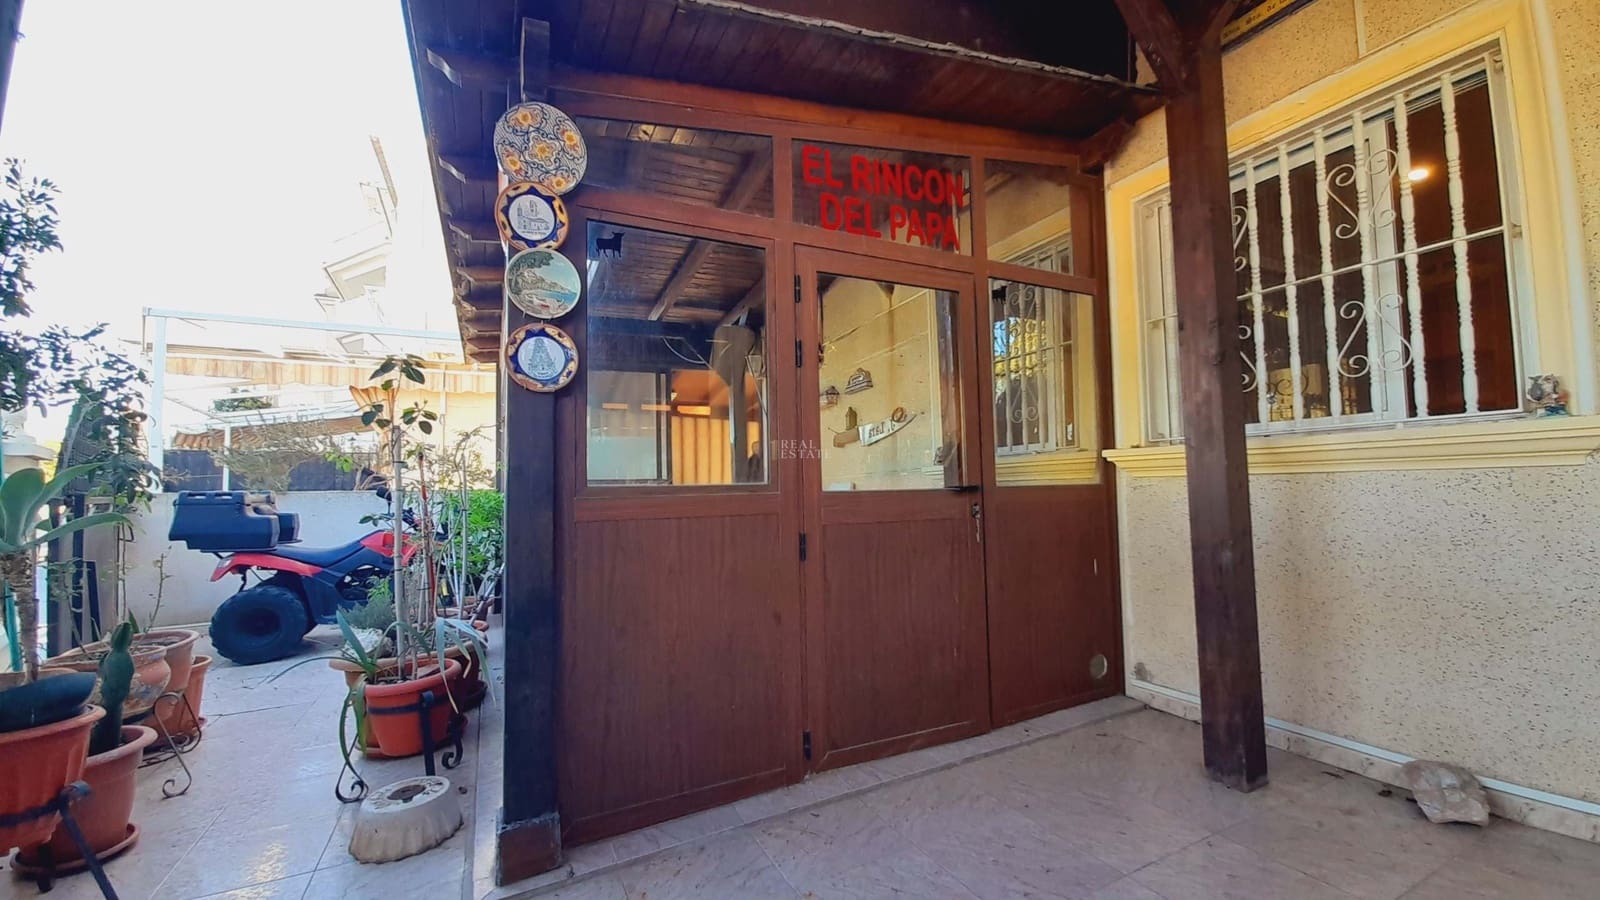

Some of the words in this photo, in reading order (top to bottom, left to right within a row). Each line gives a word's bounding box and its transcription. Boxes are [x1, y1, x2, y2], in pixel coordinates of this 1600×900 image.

[802, 145, 843, 187] EL
[851, 155, 964, 208] RINCON
[820, 192, 881, 238] DEL
[889, 205, 960, 250] PAPA
